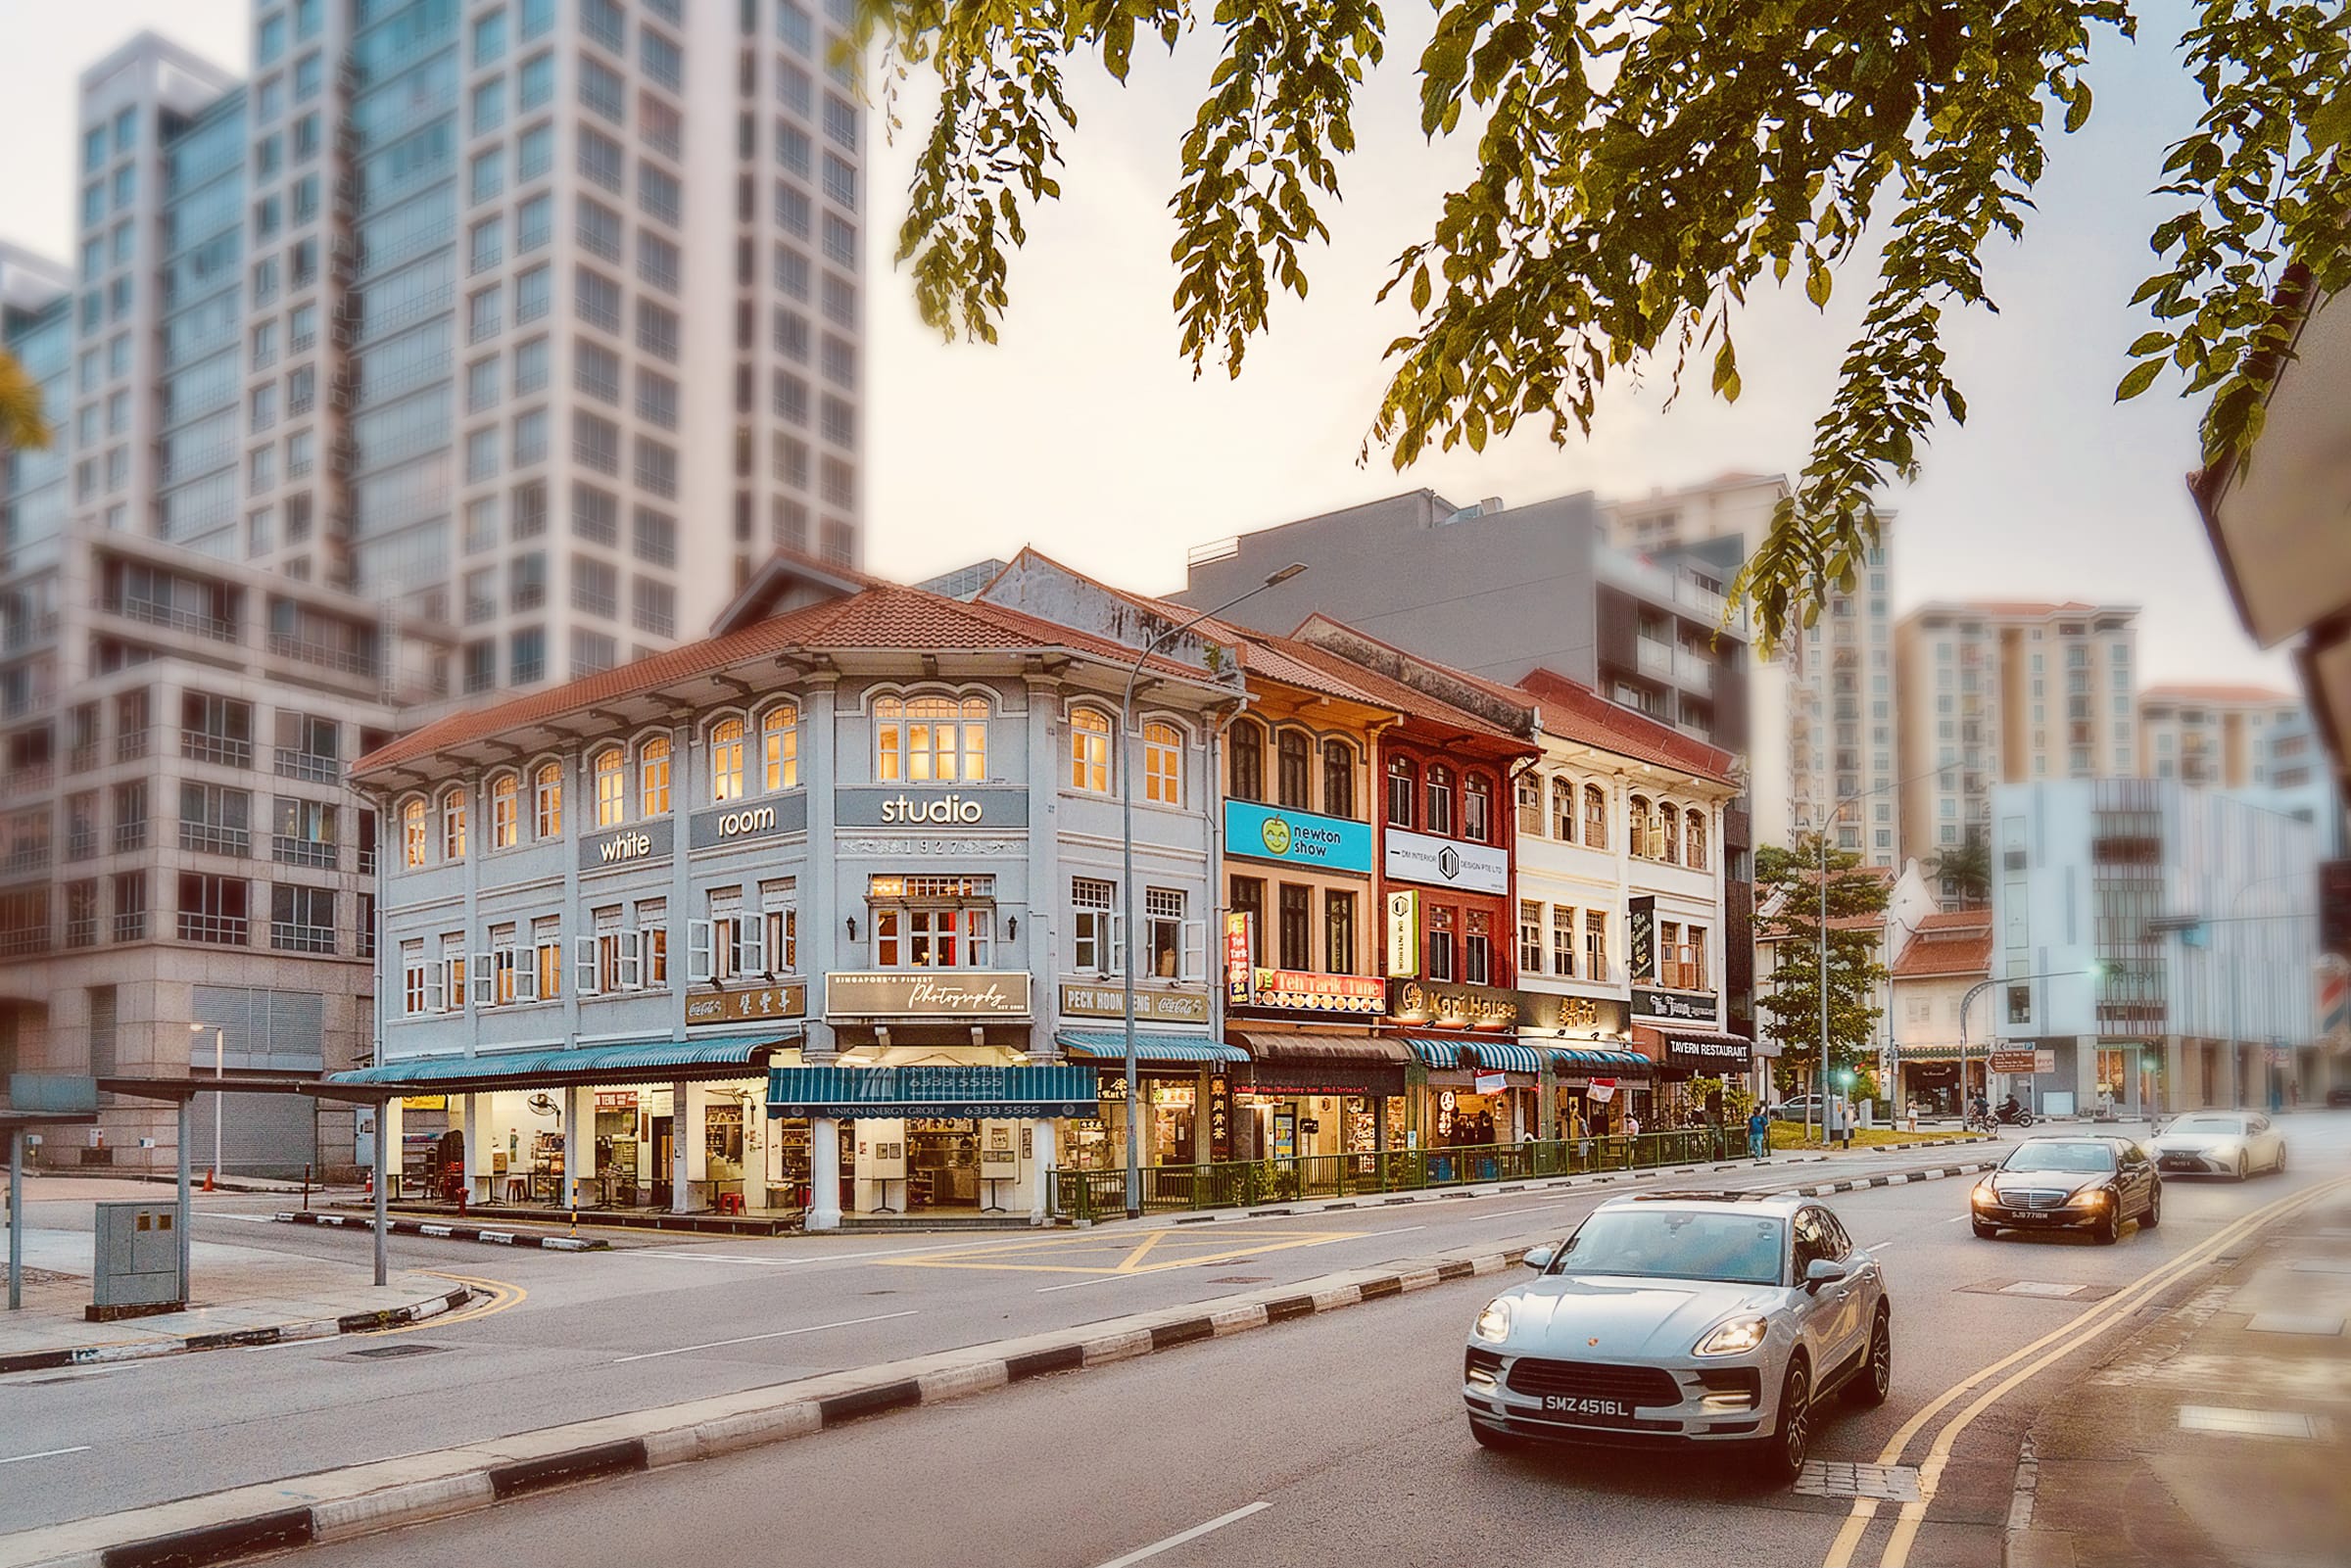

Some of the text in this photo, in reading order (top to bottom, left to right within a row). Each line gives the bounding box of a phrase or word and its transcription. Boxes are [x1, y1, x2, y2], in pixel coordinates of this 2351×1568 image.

[881, 794, 983, 824] studio
[718, 805, 776, 838] room
[1293, 826, 1341, 845] newton
[600, 832, 652, 862] white
[904, 839, 960, 855] 1927
[1294, 841, 1326, 857] show
[1401, 849, 1503, 875] DM INTERIOR DESIGN PTE LTD
[1231, 936, 1245, 947] Teh
[1230, 949, 1248, 959] Tarik
[1231, 961, 1247, 970] Time
[1233, 982, 1245, 993] 24
[1276, 973, 1380, 996] Teh Tarik Time
[908, 983, 1007, 1009] Photography
[1068, 990, 1150, 1012] PECK HOON ENG
[1231, 994, 1248, 1003] HRS
[1158, 997, 1192, 1015] Coca-Cola
[1427, 991, 1517, 1020] Kopi House
[1670, 1040, 1748, 1058] TAVERN RESTAURANT
[909, 1076, 1002, 1087] 6333 5555
[827, 1106, 1040, 1116] UNION ENERGY GROUP 6333 5555
[1213, 1100, 1226, 1140] 肉骨茶
[1546, 1396, 1629, 1416] SMZ4516L
